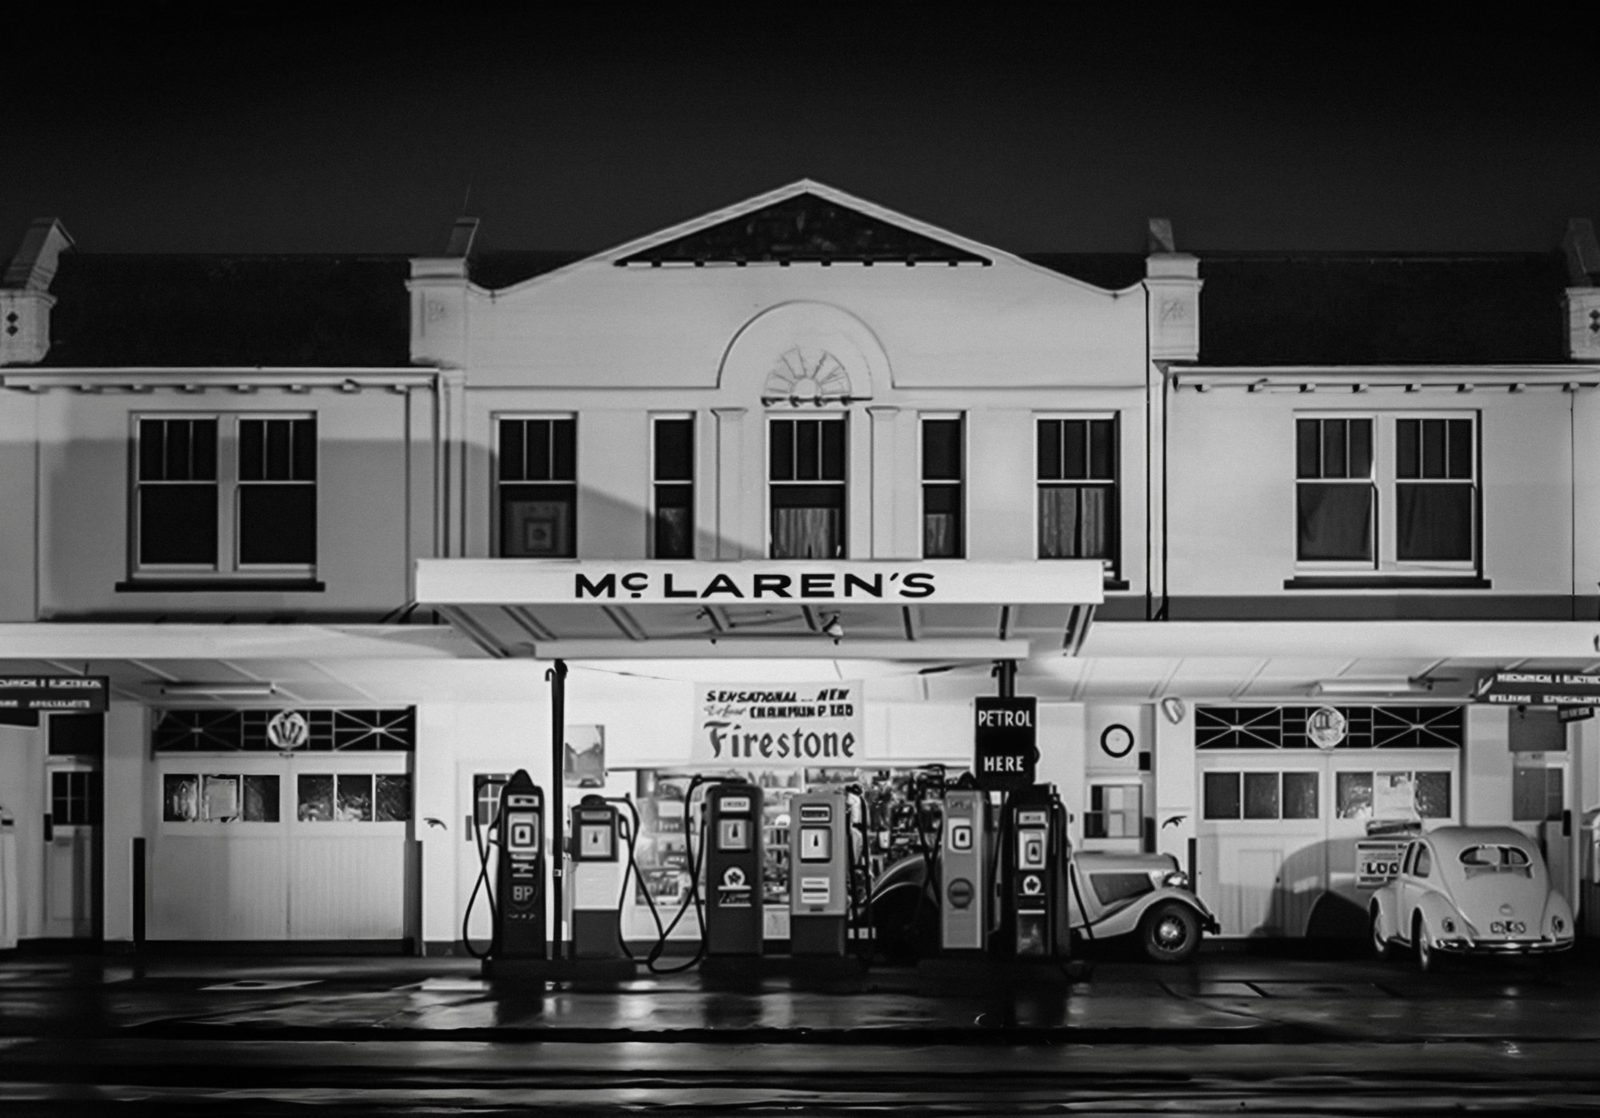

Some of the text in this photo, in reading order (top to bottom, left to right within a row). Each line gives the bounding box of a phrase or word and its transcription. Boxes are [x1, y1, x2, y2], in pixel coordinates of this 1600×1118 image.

[705, 689, 797, 703] SENSATIONAL
[816, 688, 850, 702] NEW
[978, 710, 1033, 727] PETROL
[703, 721, 856, 759] Firestone
[984, 755, 1025, 772] HERE
[513, 884, 535, 902] BP
